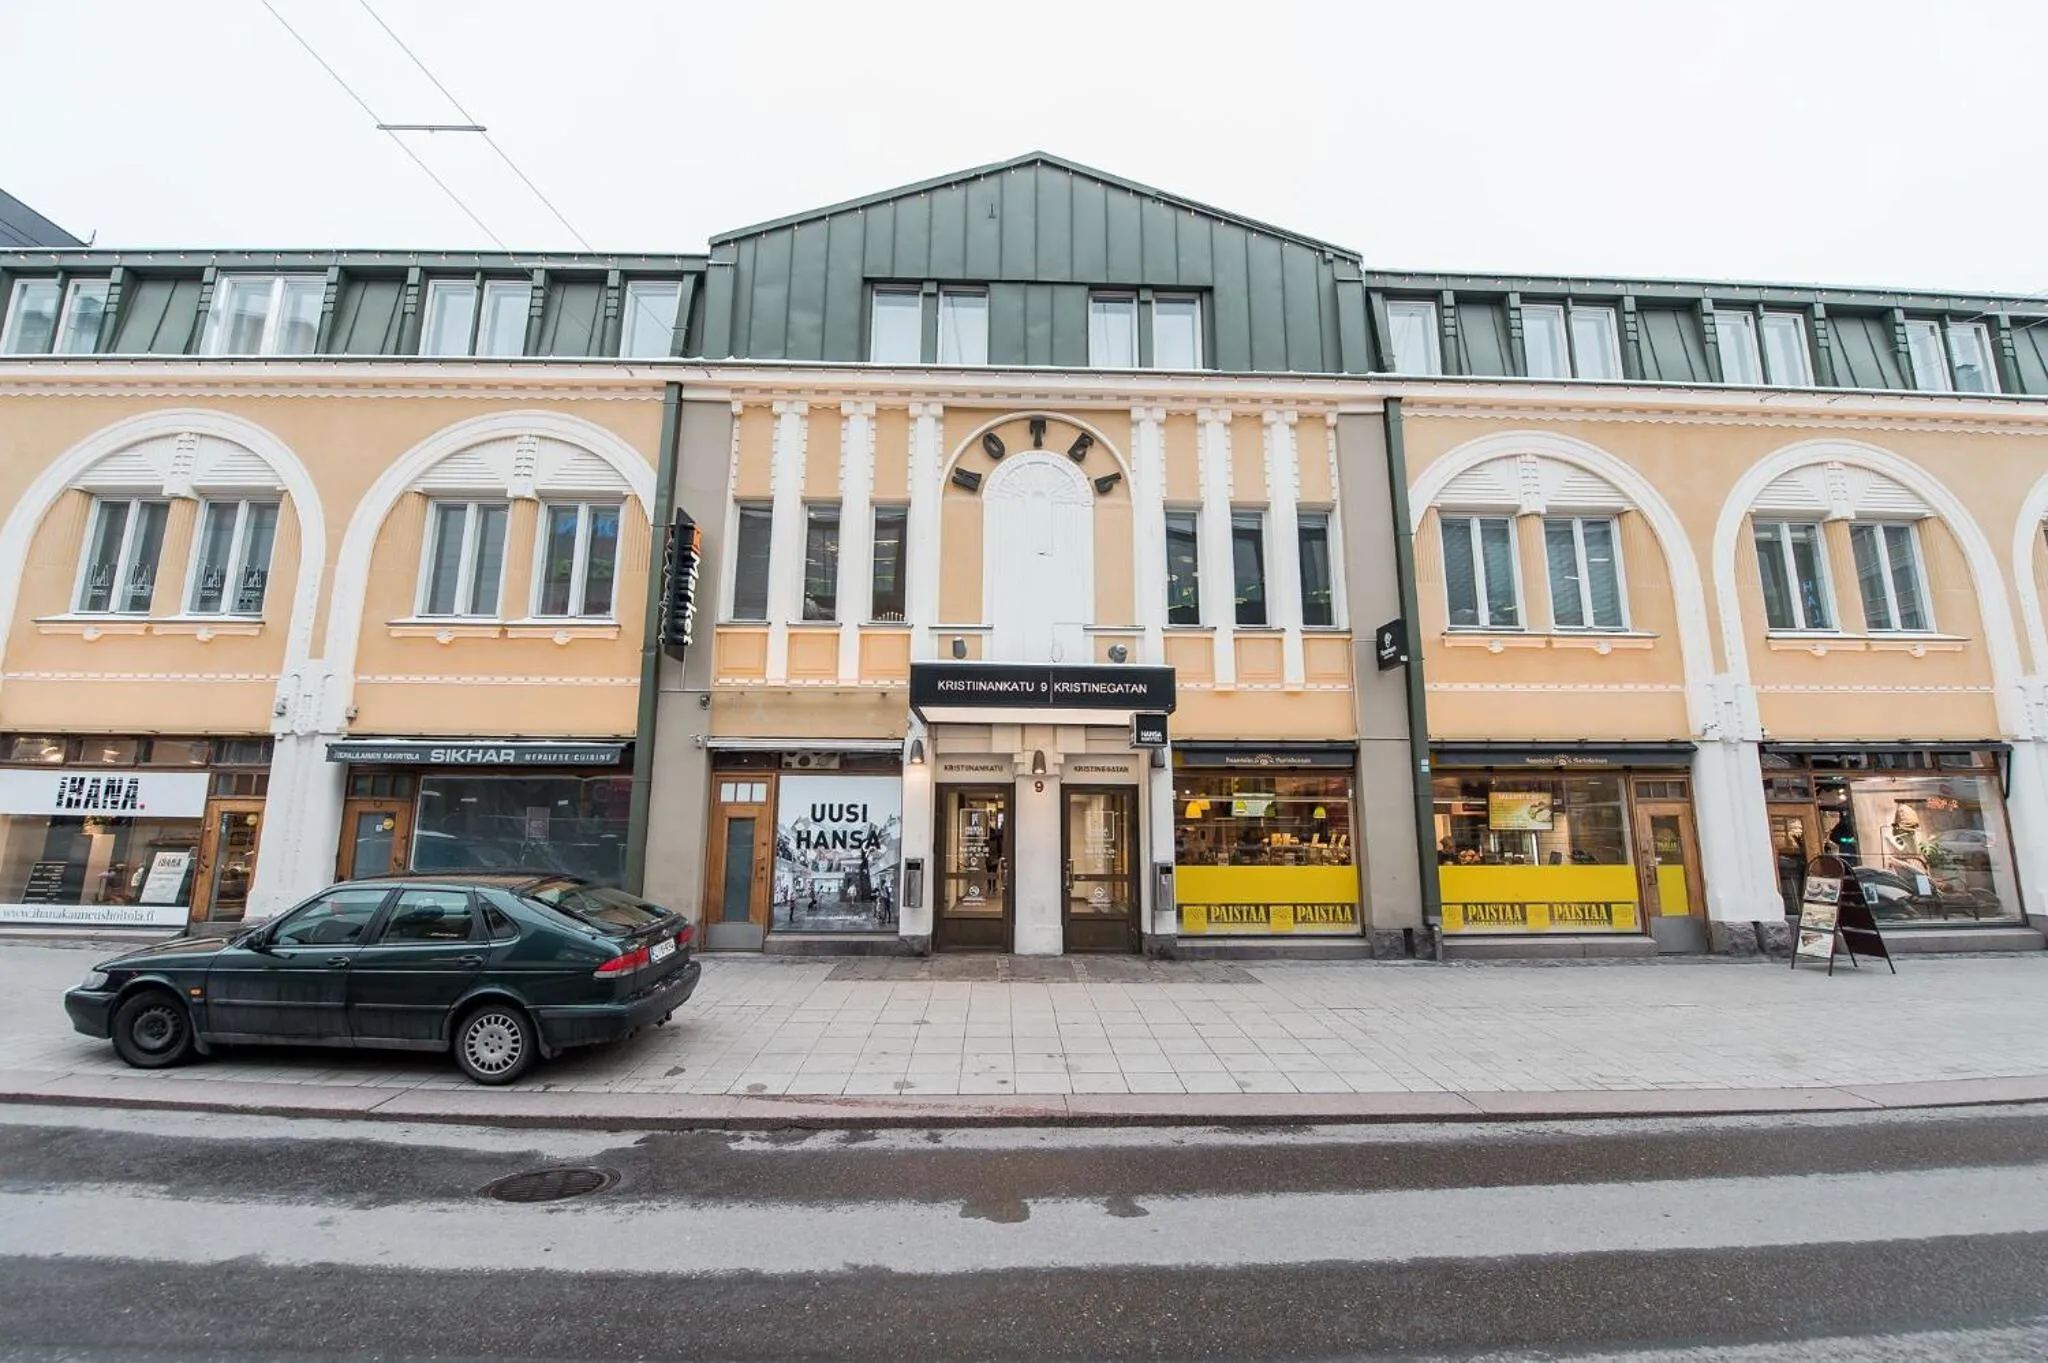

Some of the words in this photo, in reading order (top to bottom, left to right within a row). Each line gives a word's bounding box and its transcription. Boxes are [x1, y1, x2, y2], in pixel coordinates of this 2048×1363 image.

[937, 679, 1035, 692] KRISTIINANKATU
[1040, 682, 1048, 692] 9
[1053, 682, 1148, 694] KRISTINEGATAN
[430, 749, 515, 763] SIKHAR
[1034, 780, 1044, 793] 9
[810, 803, 868, 823] UUSI
[796, 829, 882, 850] HANSA
[1210, 905, 1268, 923] PAISTAA
[1296, 905, 1353, 923] PAISTAA
[1467, 904, 1523, 922] PAISTAA
[1554, 904, 1608, 921] PAISTAA
